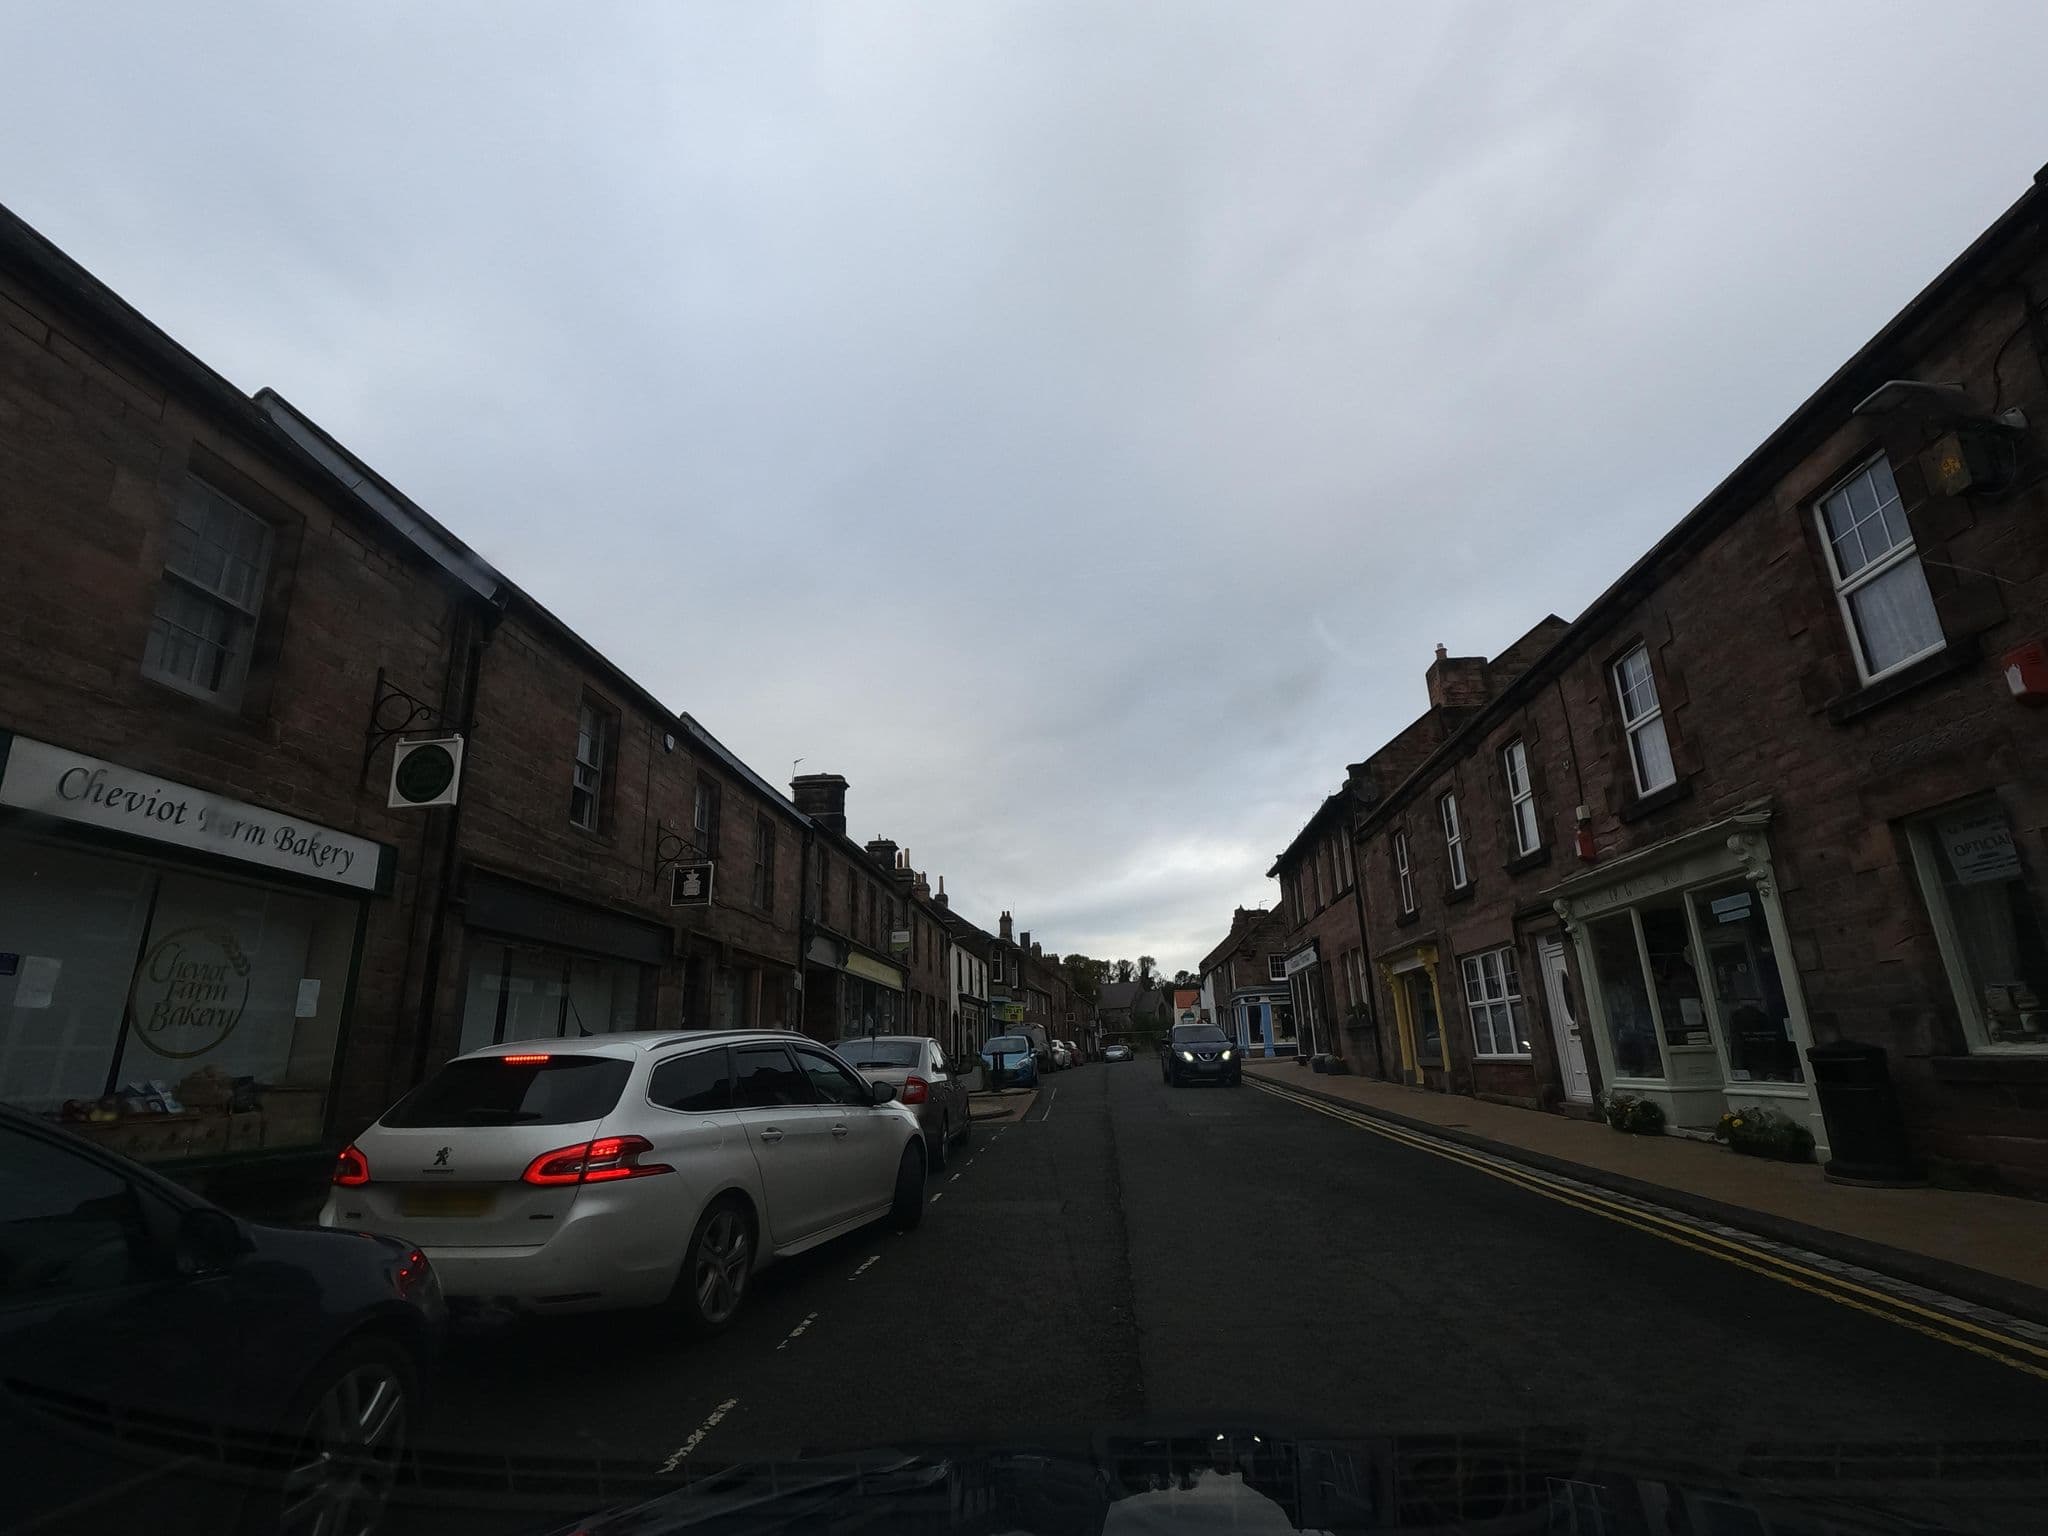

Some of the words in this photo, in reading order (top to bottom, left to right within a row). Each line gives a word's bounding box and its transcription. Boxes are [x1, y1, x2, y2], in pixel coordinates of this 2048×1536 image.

[56, 767, 188, 825] Cheviot
[198, 806, 267, 845] rm
[273, 825, 356, 875] Bakery
[151, 943, 229, 983] Cheviot
[164, 978, 229, 1002] Farm
[149, 1001, 237, 1031] Bakery
